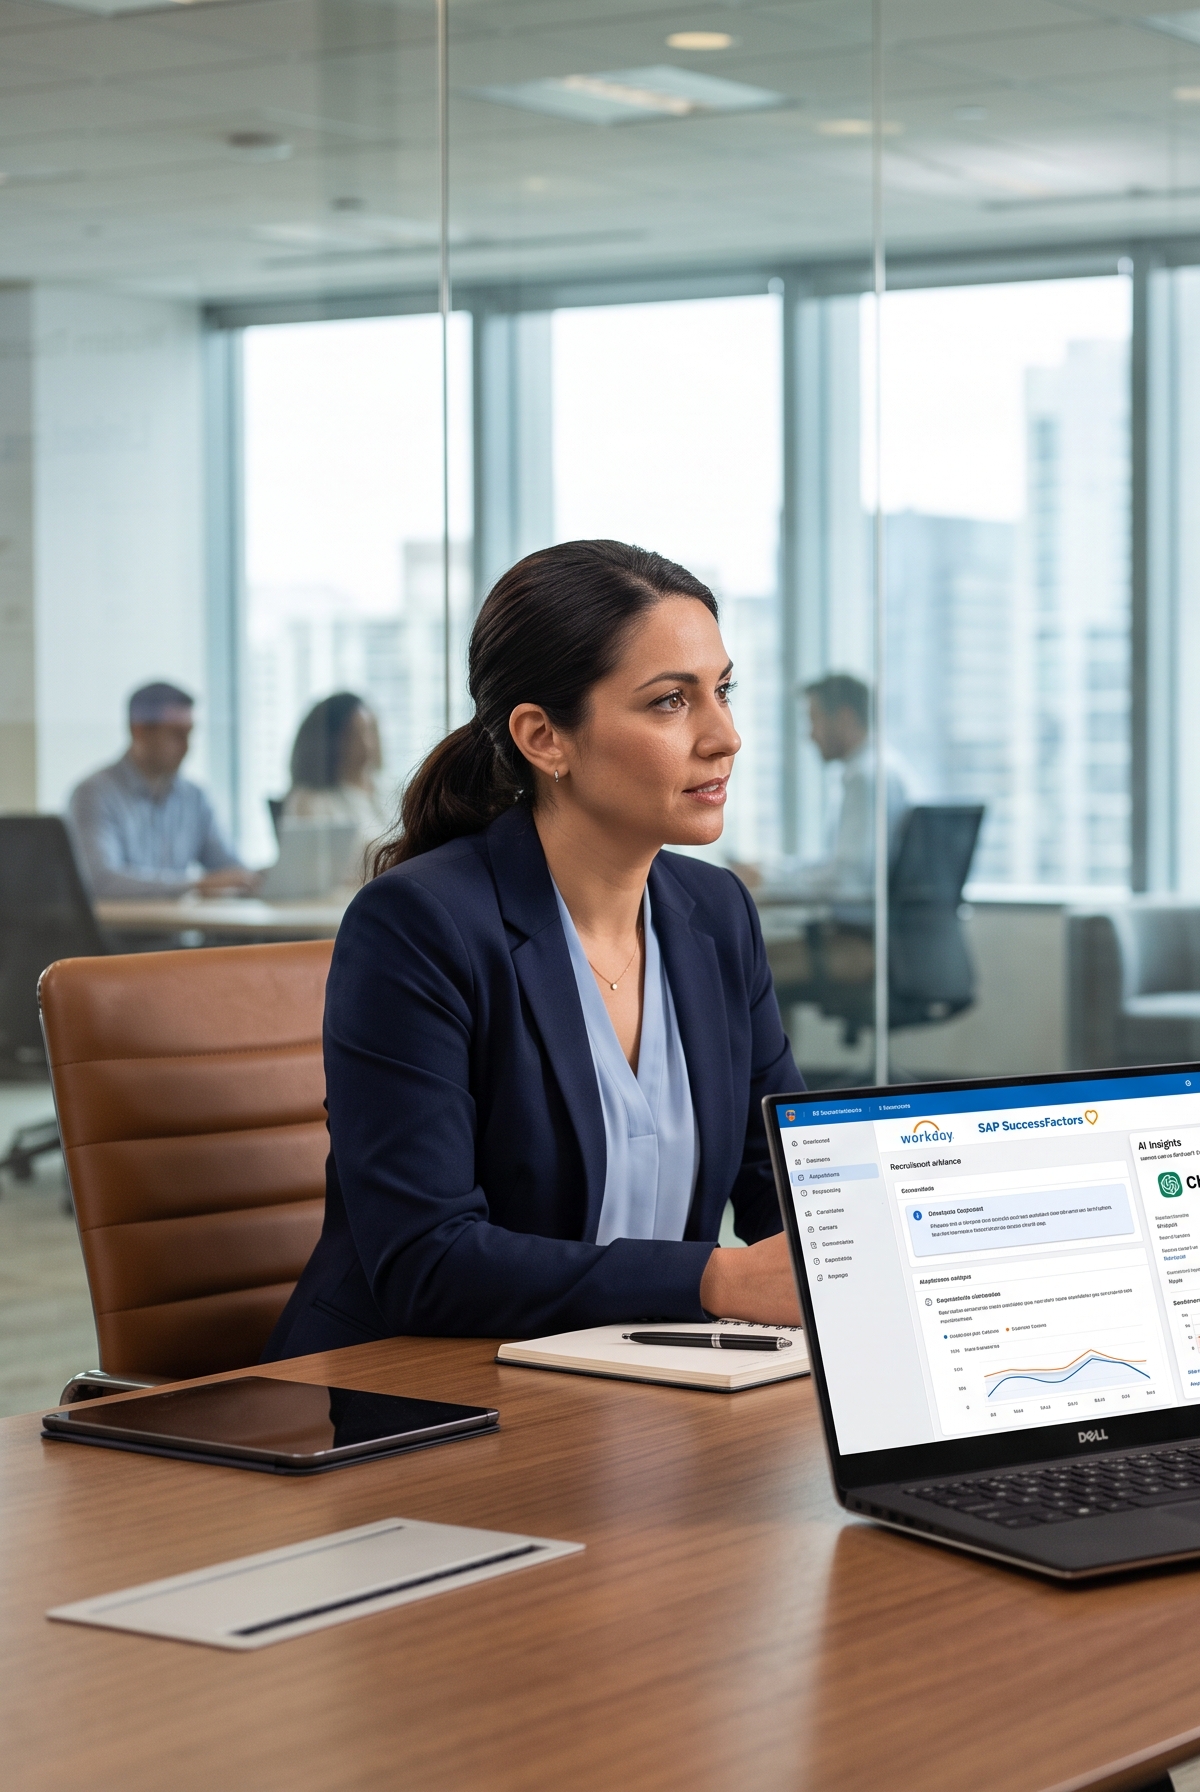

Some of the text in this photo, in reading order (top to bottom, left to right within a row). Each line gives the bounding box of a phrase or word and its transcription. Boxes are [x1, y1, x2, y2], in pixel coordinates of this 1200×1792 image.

[977, 1115, 1084, 1134] SAP SuccessFactors
[1138, 1138, 1182, 1151] AI Insights
[1077, 1428, 1109, 1444] DELL
